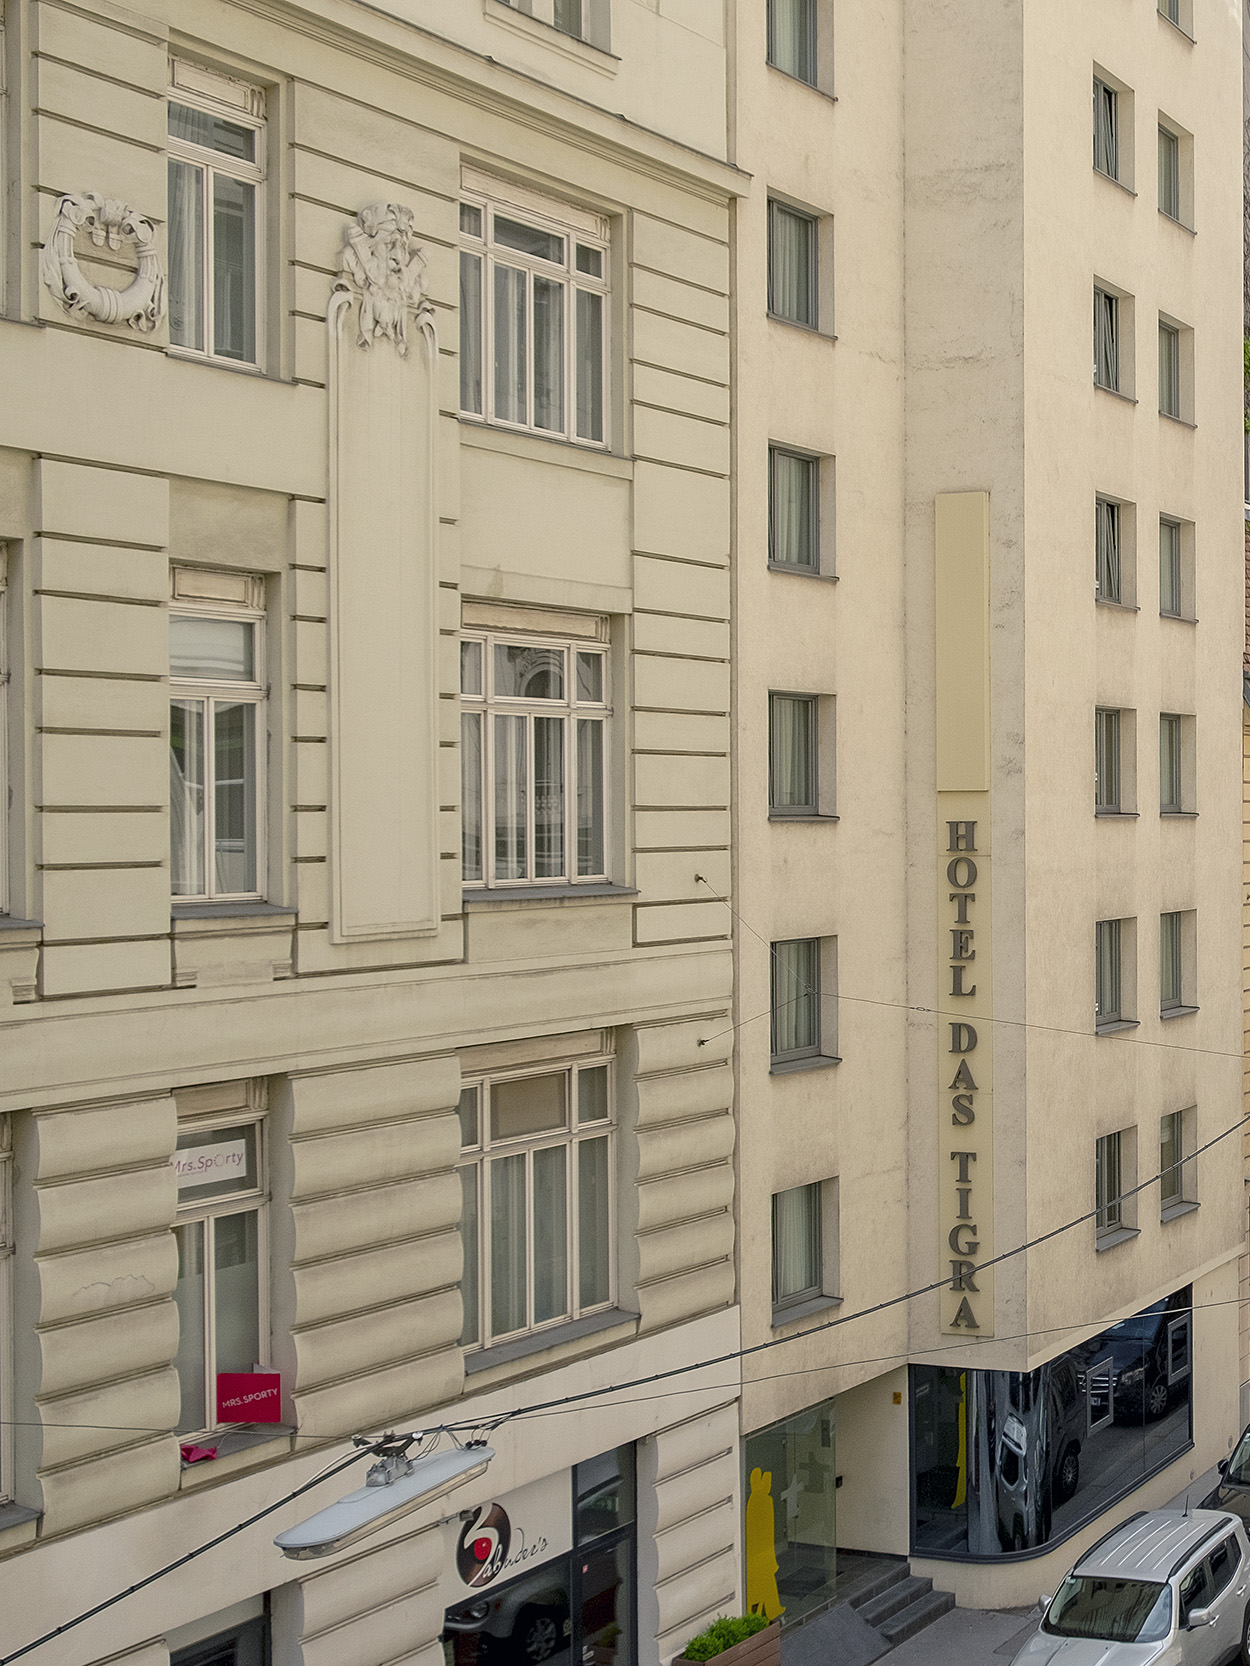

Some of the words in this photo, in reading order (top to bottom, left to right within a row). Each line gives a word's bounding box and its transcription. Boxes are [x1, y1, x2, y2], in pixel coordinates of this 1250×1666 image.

[945, 820, 978, 997] HOTEL
[948, 1022, 979, 1127] DAS
[948, 1151, 980, 1330] TIGRA
